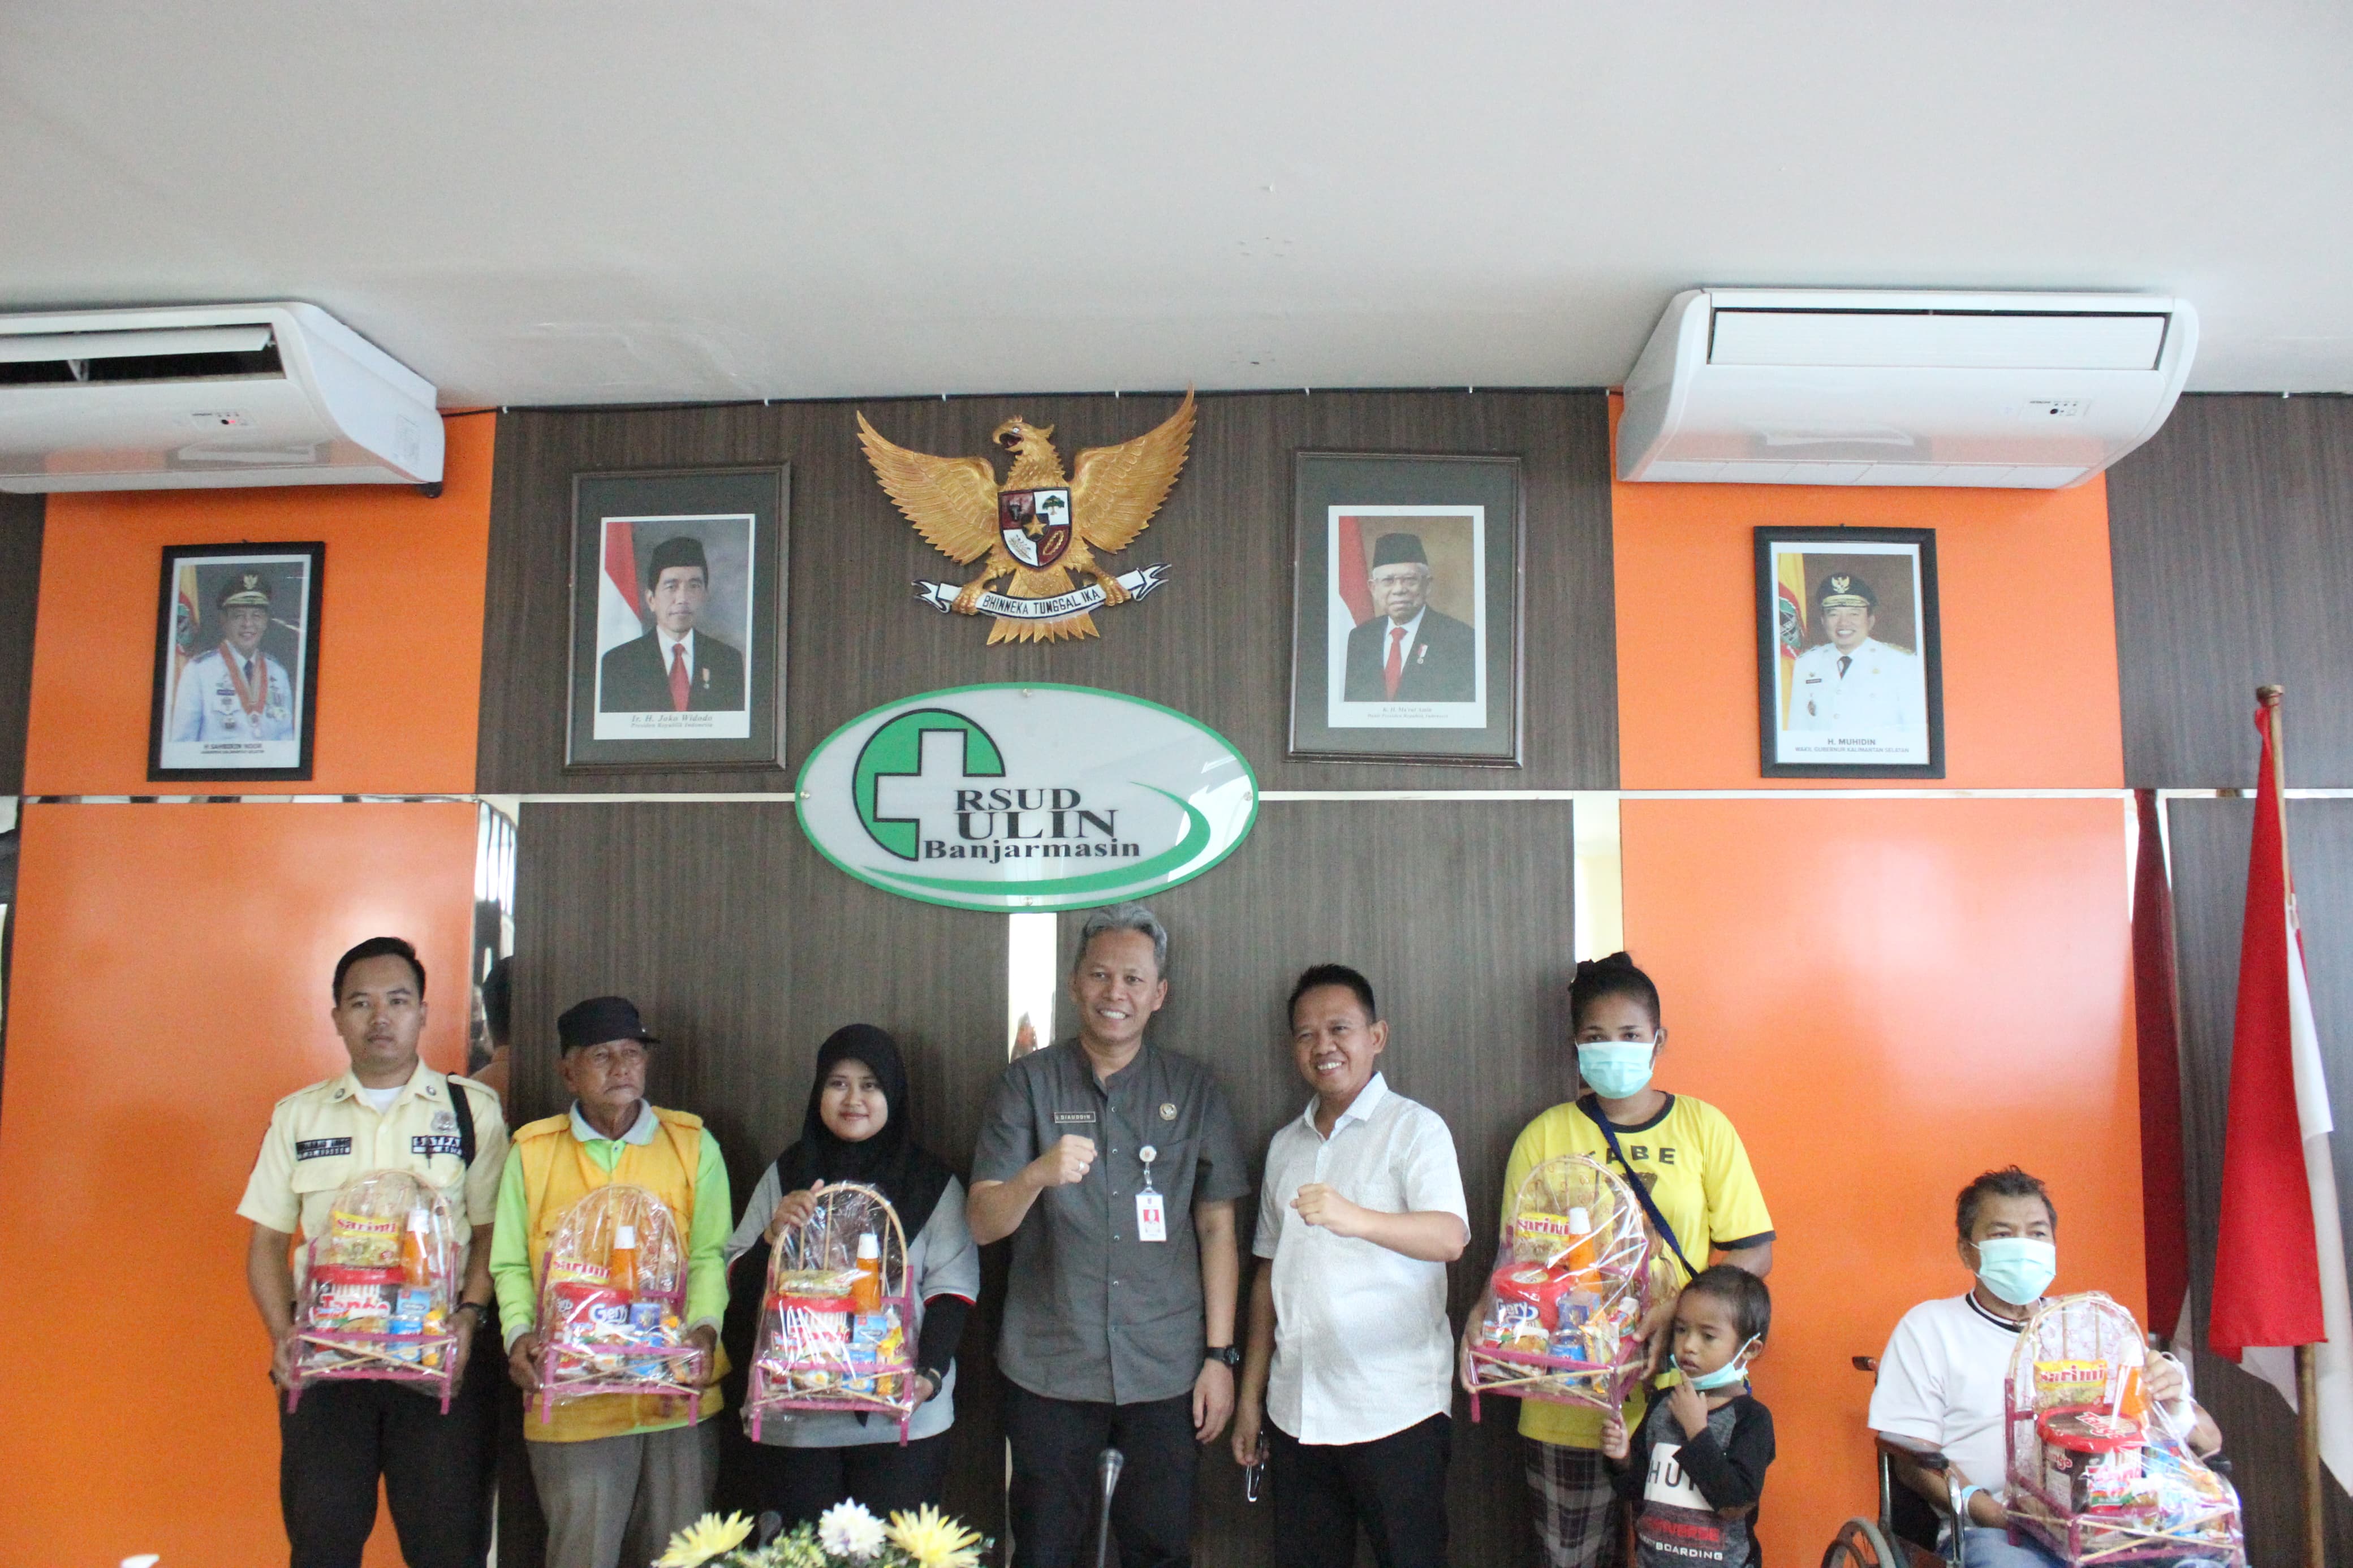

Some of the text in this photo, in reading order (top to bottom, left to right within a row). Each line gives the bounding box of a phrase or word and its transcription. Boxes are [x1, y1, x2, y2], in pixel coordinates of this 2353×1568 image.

[982, 589, 1100, 615] BHINNEKA TUNGGAL IKA
[955, 788, 1081, 811] RSUD
[953, 809, 1119, 840] ULIN
[923, 838, 1141, 864] Banjarmasin
[2040, 1364, 2104, 1383] sarimi
[1648, 1461, 1695, 1491] HU
[1656, 1541, 1723, 1561] BOARDING
